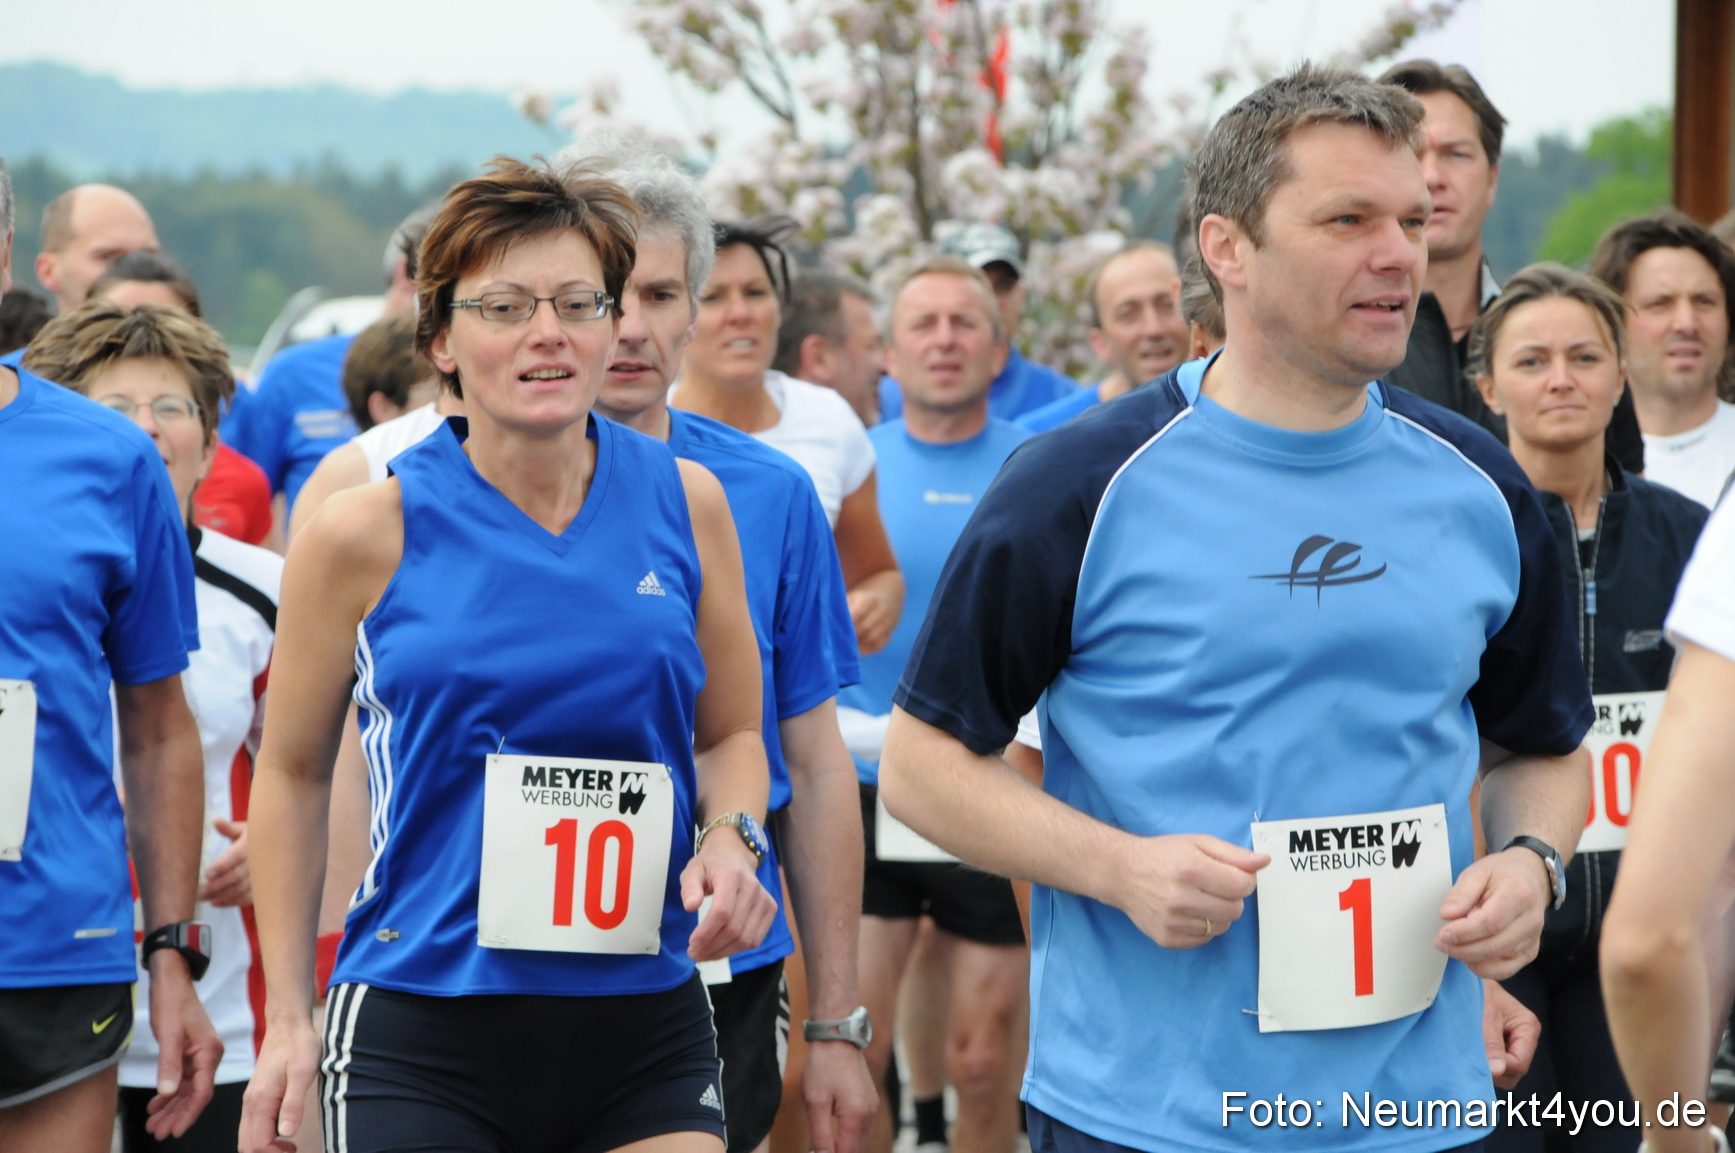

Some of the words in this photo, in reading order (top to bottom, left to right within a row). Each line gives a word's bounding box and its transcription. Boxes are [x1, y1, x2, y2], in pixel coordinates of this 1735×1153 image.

[637, 586, 666, 596] adidas
[522, 765, 613, 792] MEYER
[522, 788, 613, 809] WERBUNG
[1288, 823, 1385, 854] MEYER
[545, 818, 634, 930] 10
[1290, 849, 1386, 873] WERBUNG
[1338, 877, 1374, 997] 1
